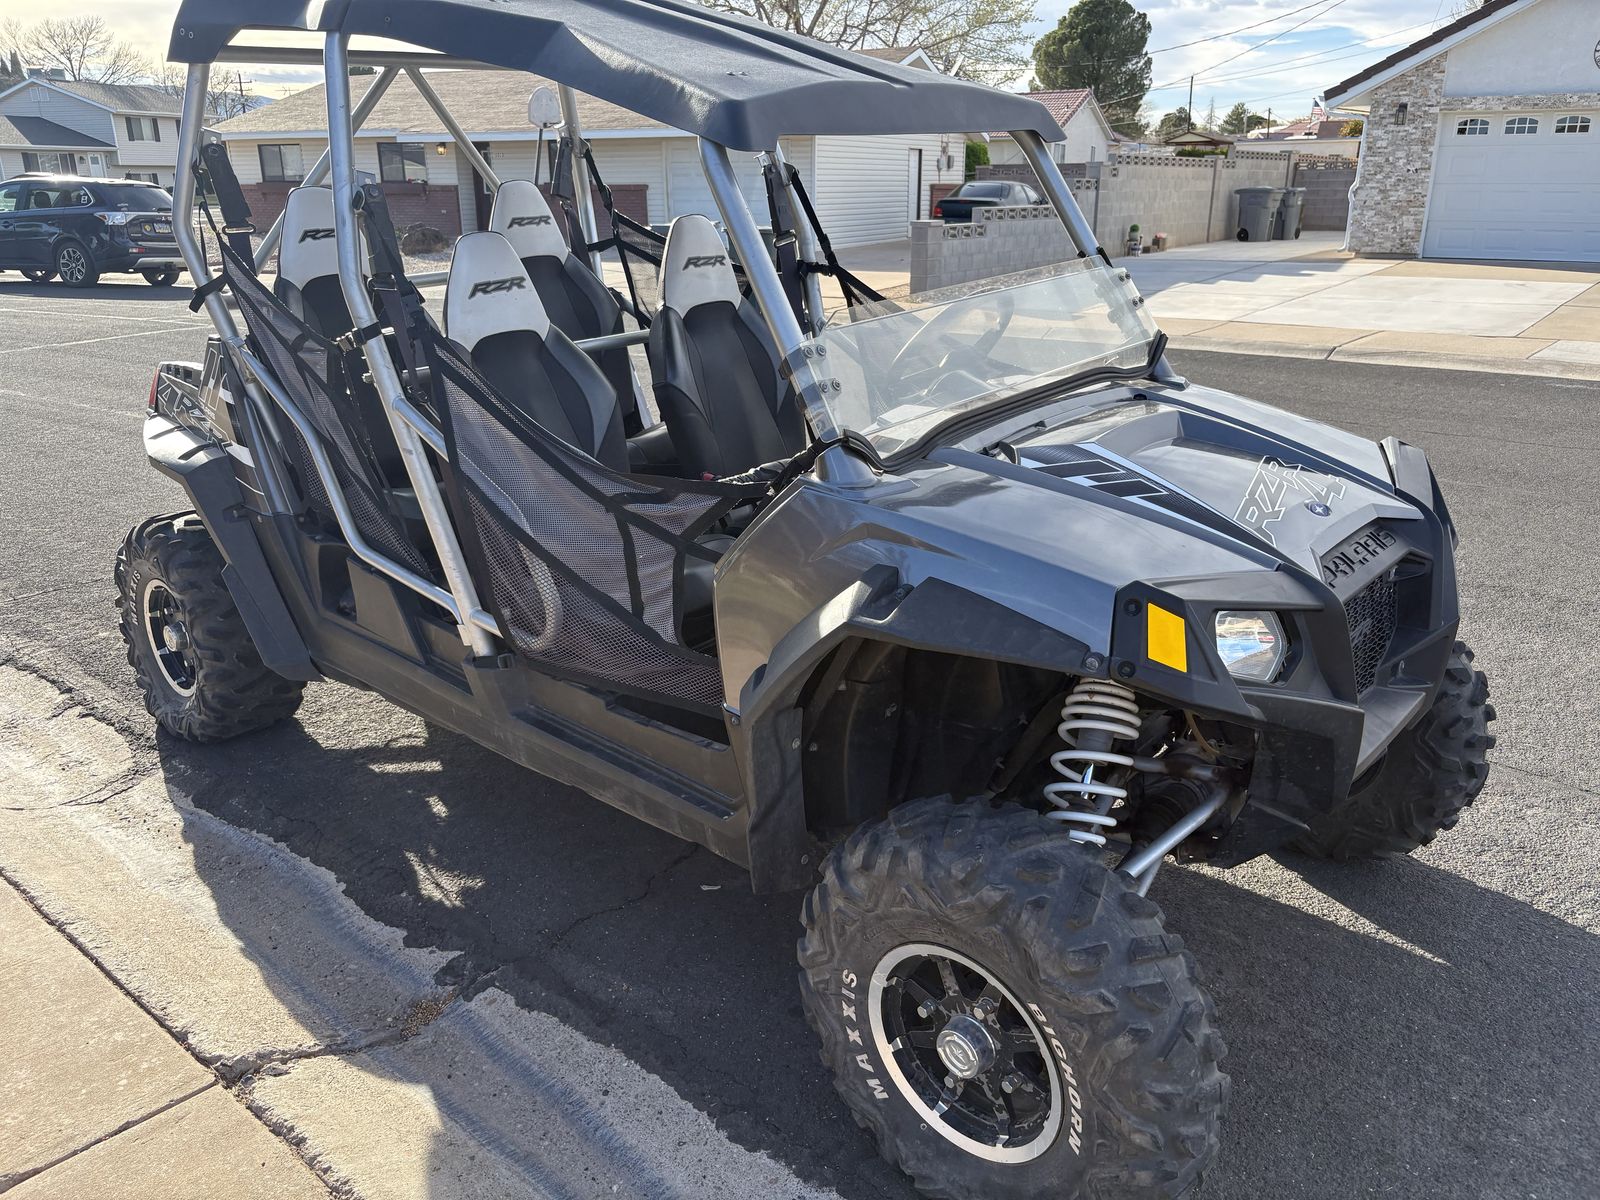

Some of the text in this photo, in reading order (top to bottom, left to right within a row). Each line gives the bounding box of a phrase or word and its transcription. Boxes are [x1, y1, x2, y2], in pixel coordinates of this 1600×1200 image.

[506, 214, 552, 231] RZR
[298, 228, 336, 244] RZ
[682, 254, 727, 272] RZR
[468, 275, 527, 300] RZR
[130, 570, 141, 626] MAXXIS
[841, 968, 890, 1101] MAXXIS
[1027, 1002, 1084, 1157] BIGHORN
